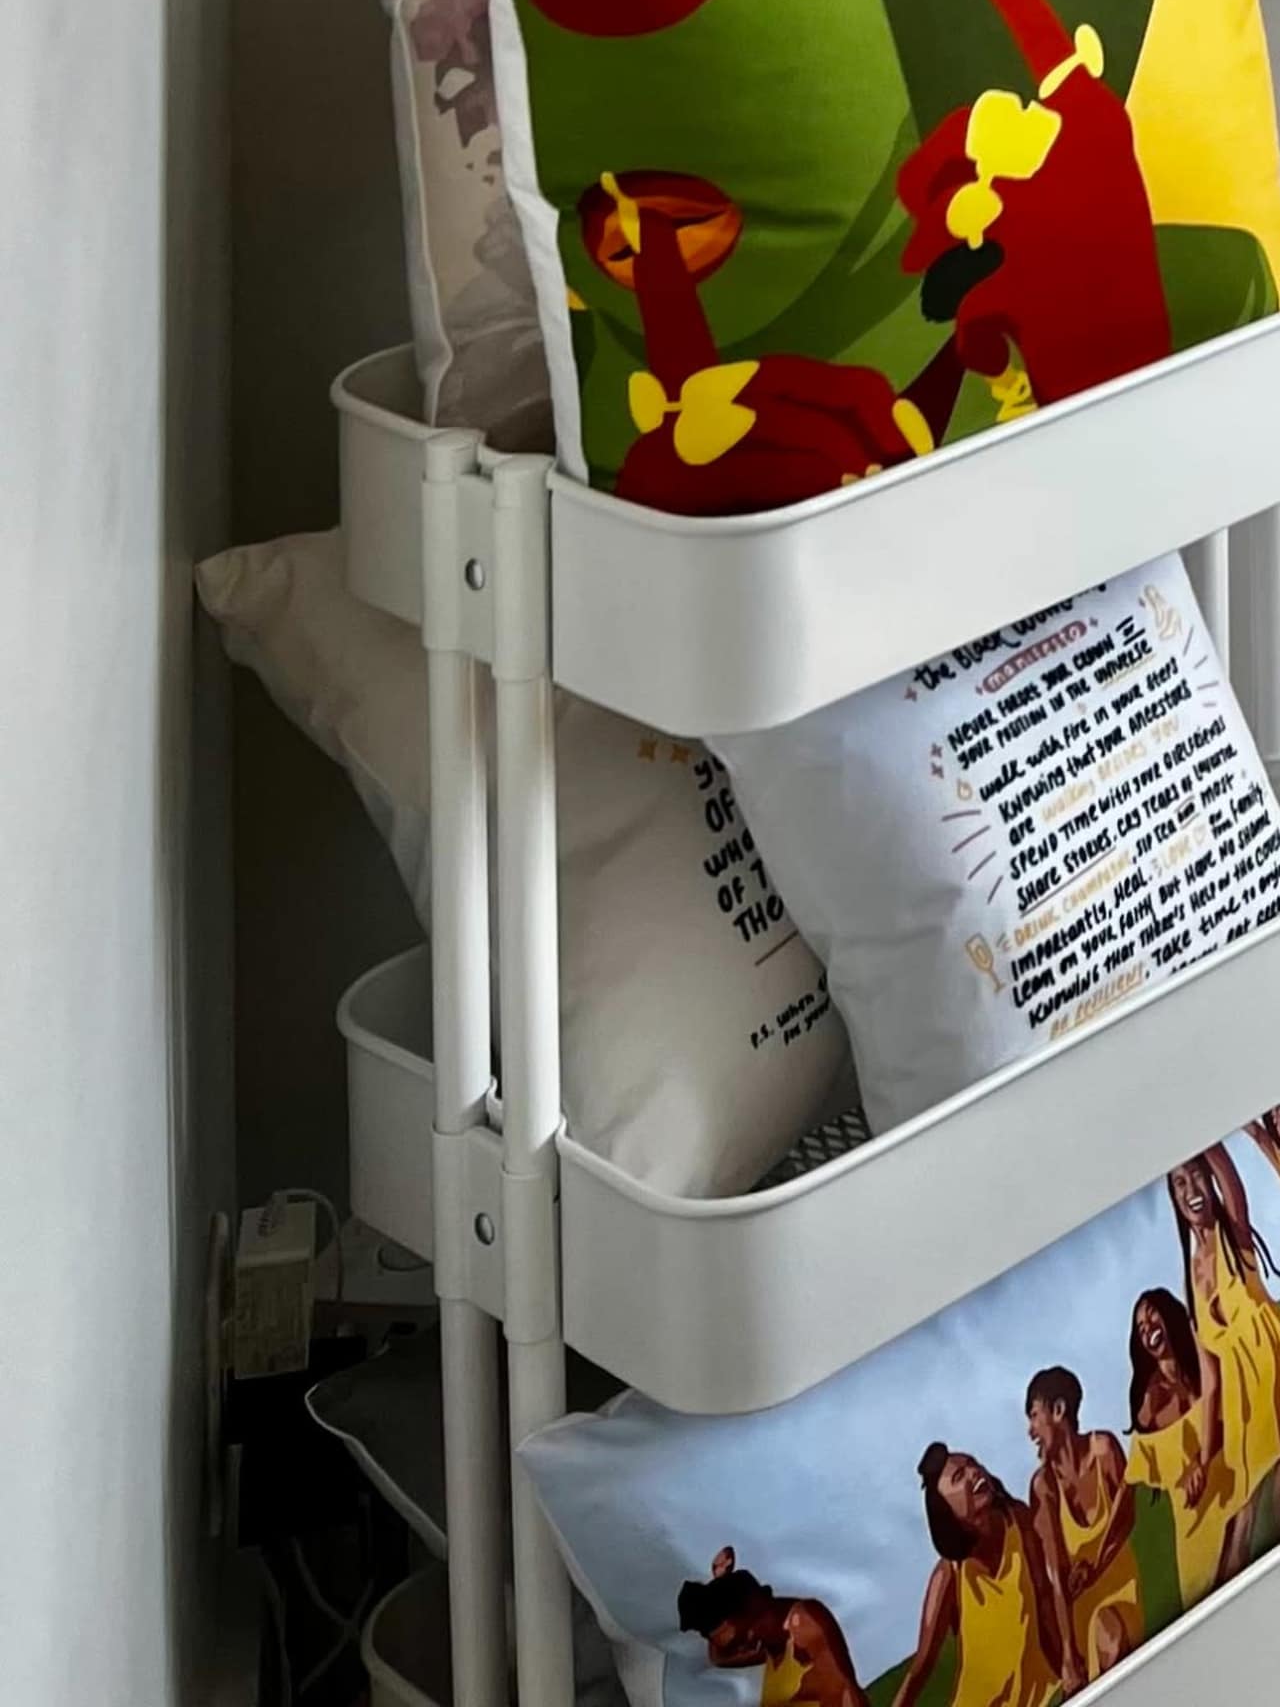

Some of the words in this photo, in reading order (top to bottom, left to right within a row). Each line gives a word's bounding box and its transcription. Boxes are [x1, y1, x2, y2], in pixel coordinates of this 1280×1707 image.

[914, 663, 956, 690] the
[705, 786, 734, 833] OF
[718, 875, 744, 913] OF
